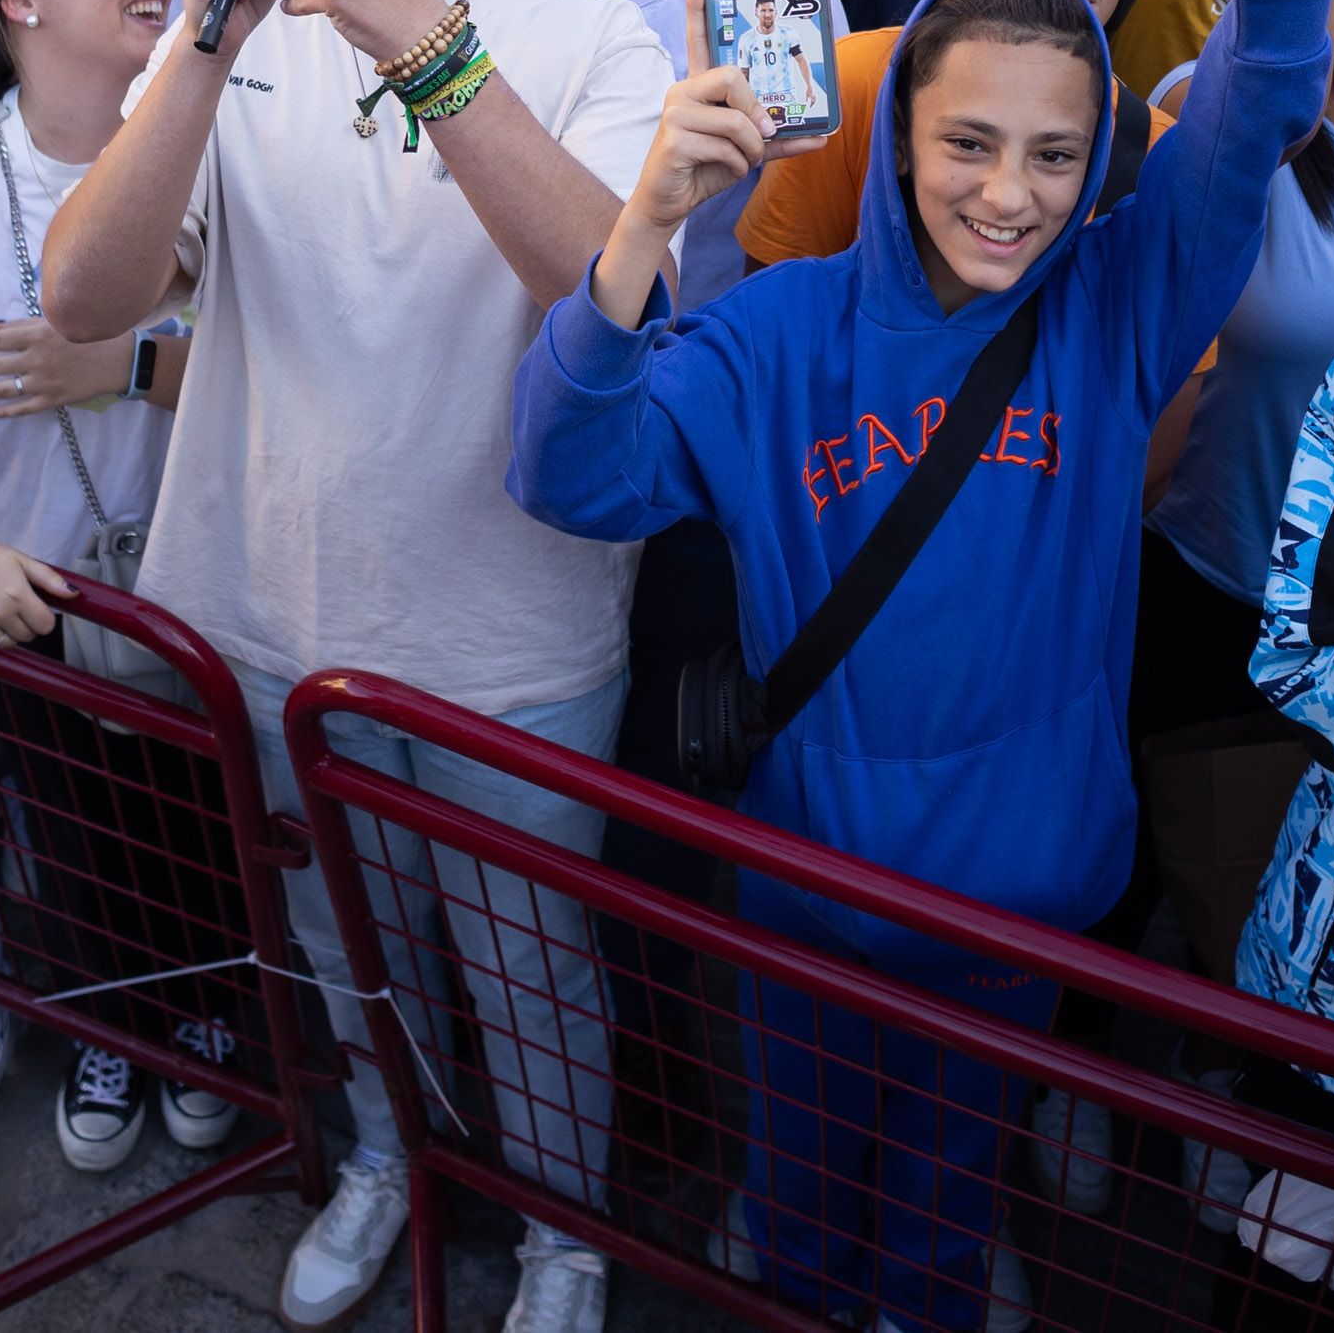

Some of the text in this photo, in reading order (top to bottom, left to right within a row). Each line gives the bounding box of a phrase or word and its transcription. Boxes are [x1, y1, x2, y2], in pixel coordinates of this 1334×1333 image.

[764, 51, 776, 66] 10
[228, 74, 274, 94] VAN GOGH
[438, 69, 452, 84] DAY
[763, 94, 786, 103] HERO
[789, 104, 802, 115] 88
